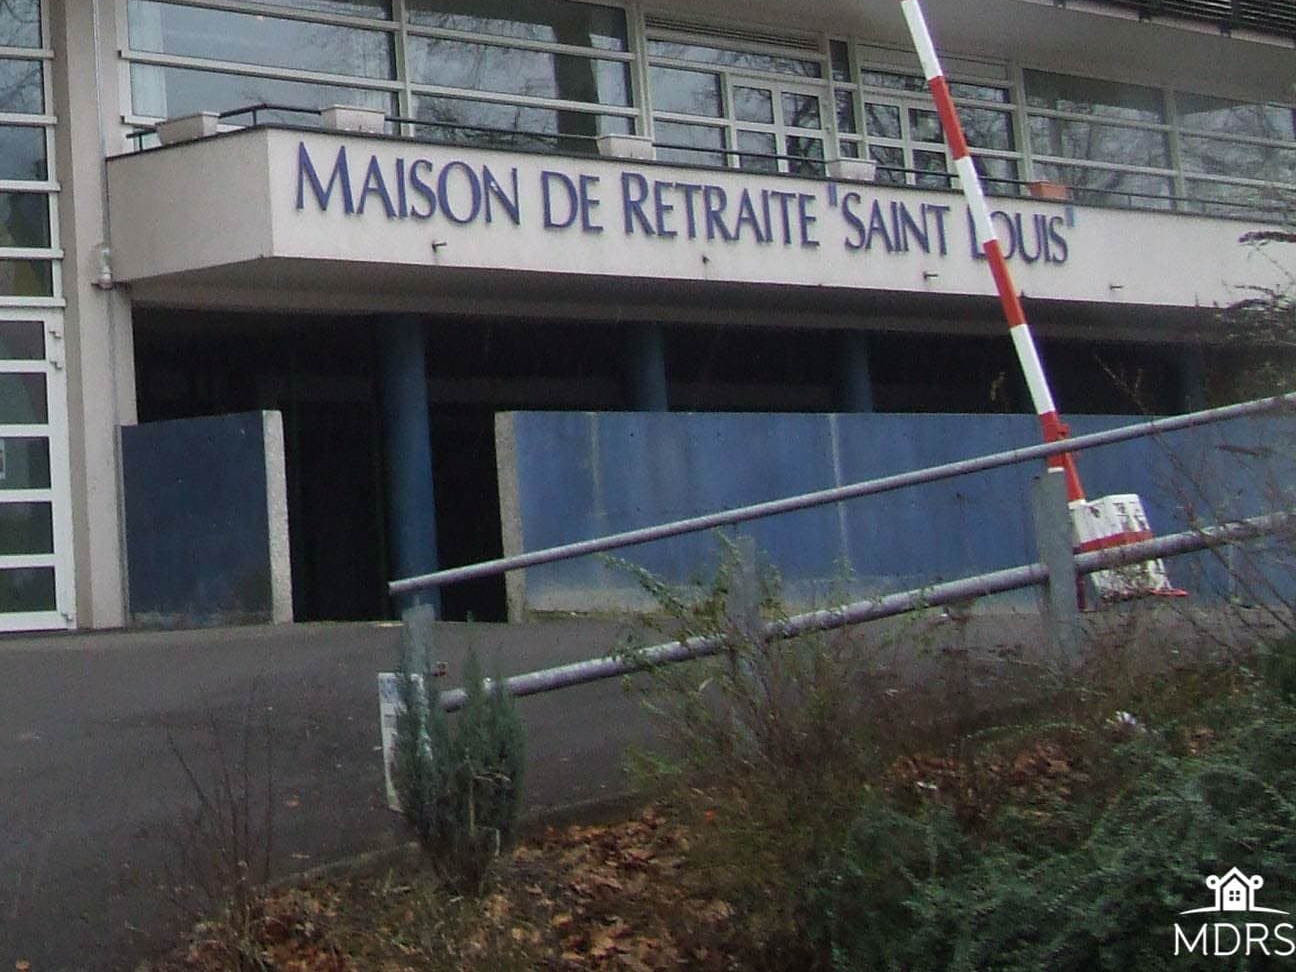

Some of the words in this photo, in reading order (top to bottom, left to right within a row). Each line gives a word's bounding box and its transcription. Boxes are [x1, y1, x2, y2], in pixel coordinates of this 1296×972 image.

[296, 141, 521, 226] MAISON
[541, 170, 604, 233] DE
[621, 171, 821, 246] RETRAITE
